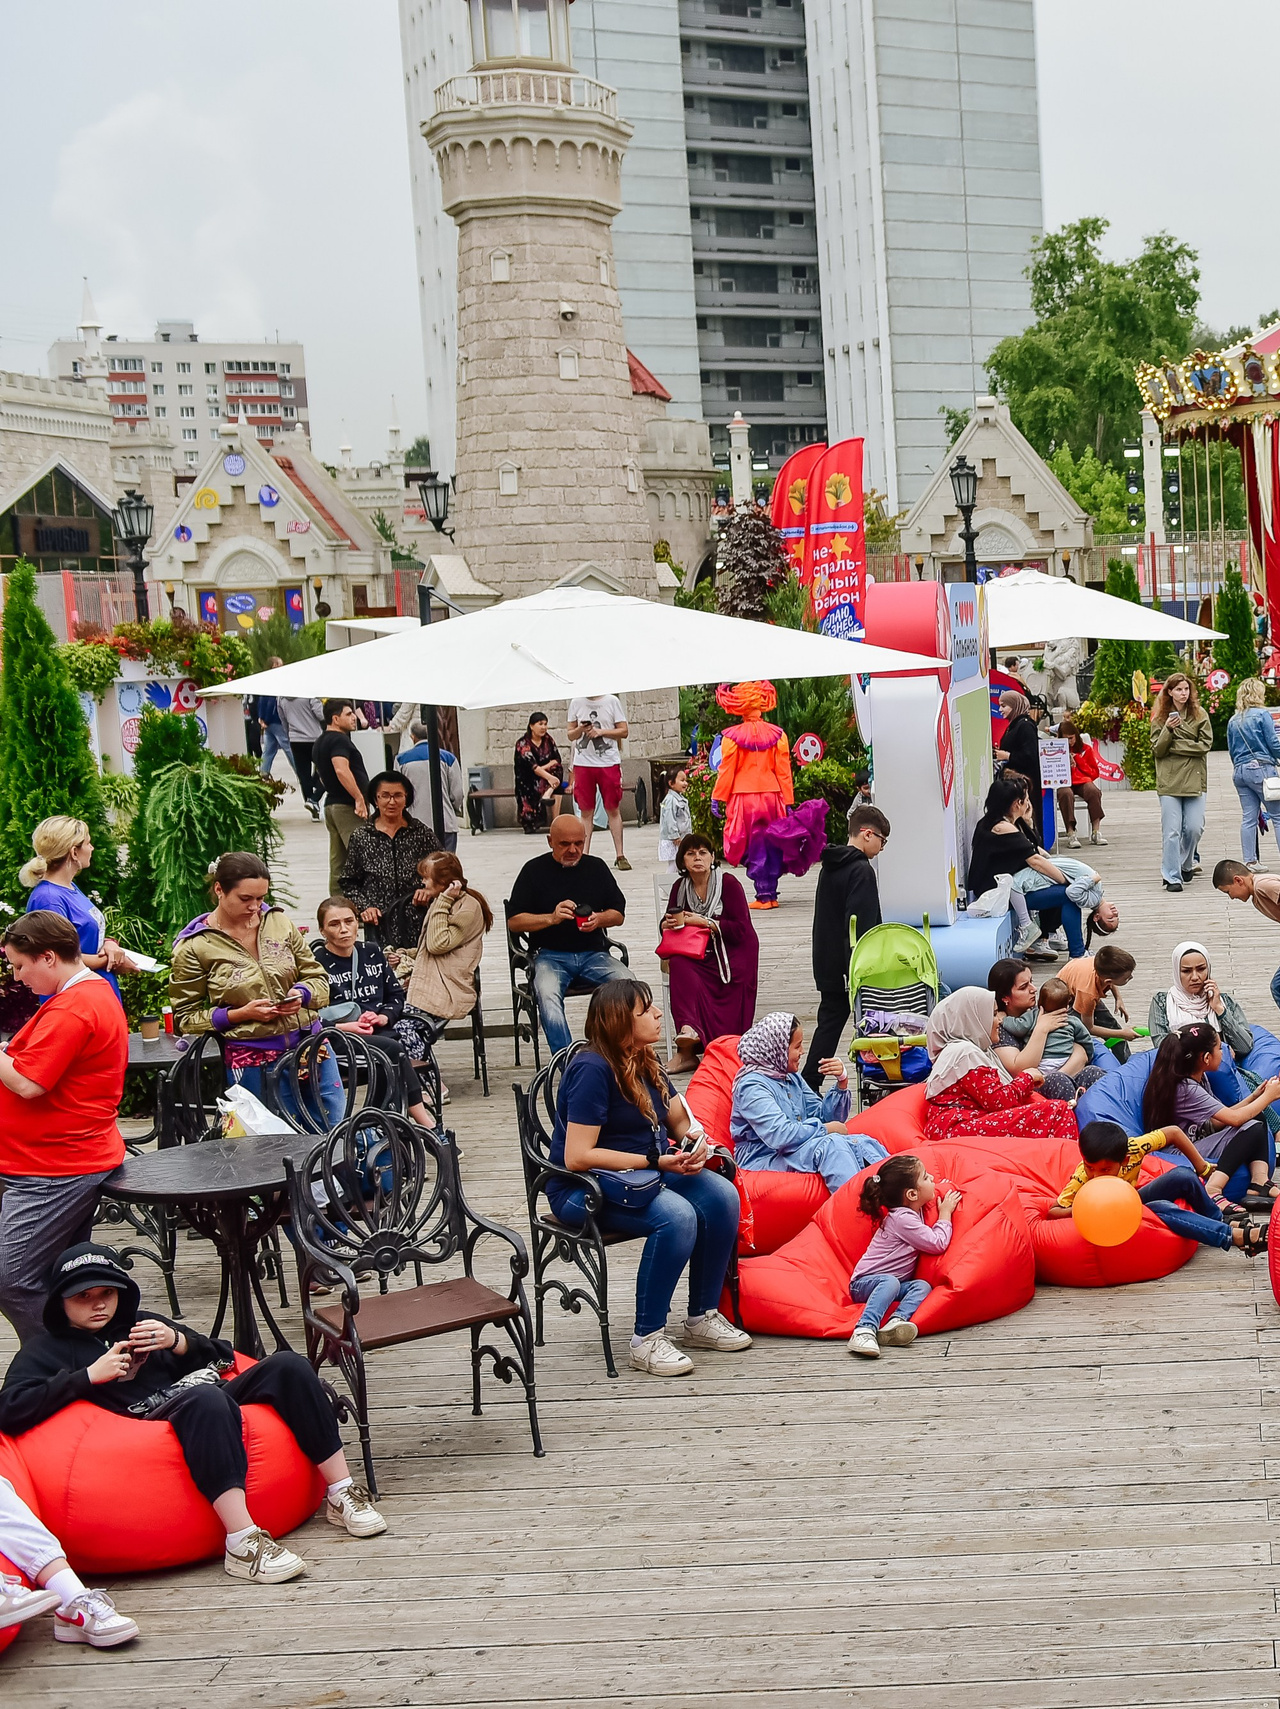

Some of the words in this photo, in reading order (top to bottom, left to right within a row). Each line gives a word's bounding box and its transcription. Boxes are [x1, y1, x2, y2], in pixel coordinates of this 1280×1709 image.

[813, 559, 861, 578] спаль-
[814, 591, 860, 614] район
[364, 963, 383, 978] NOT
